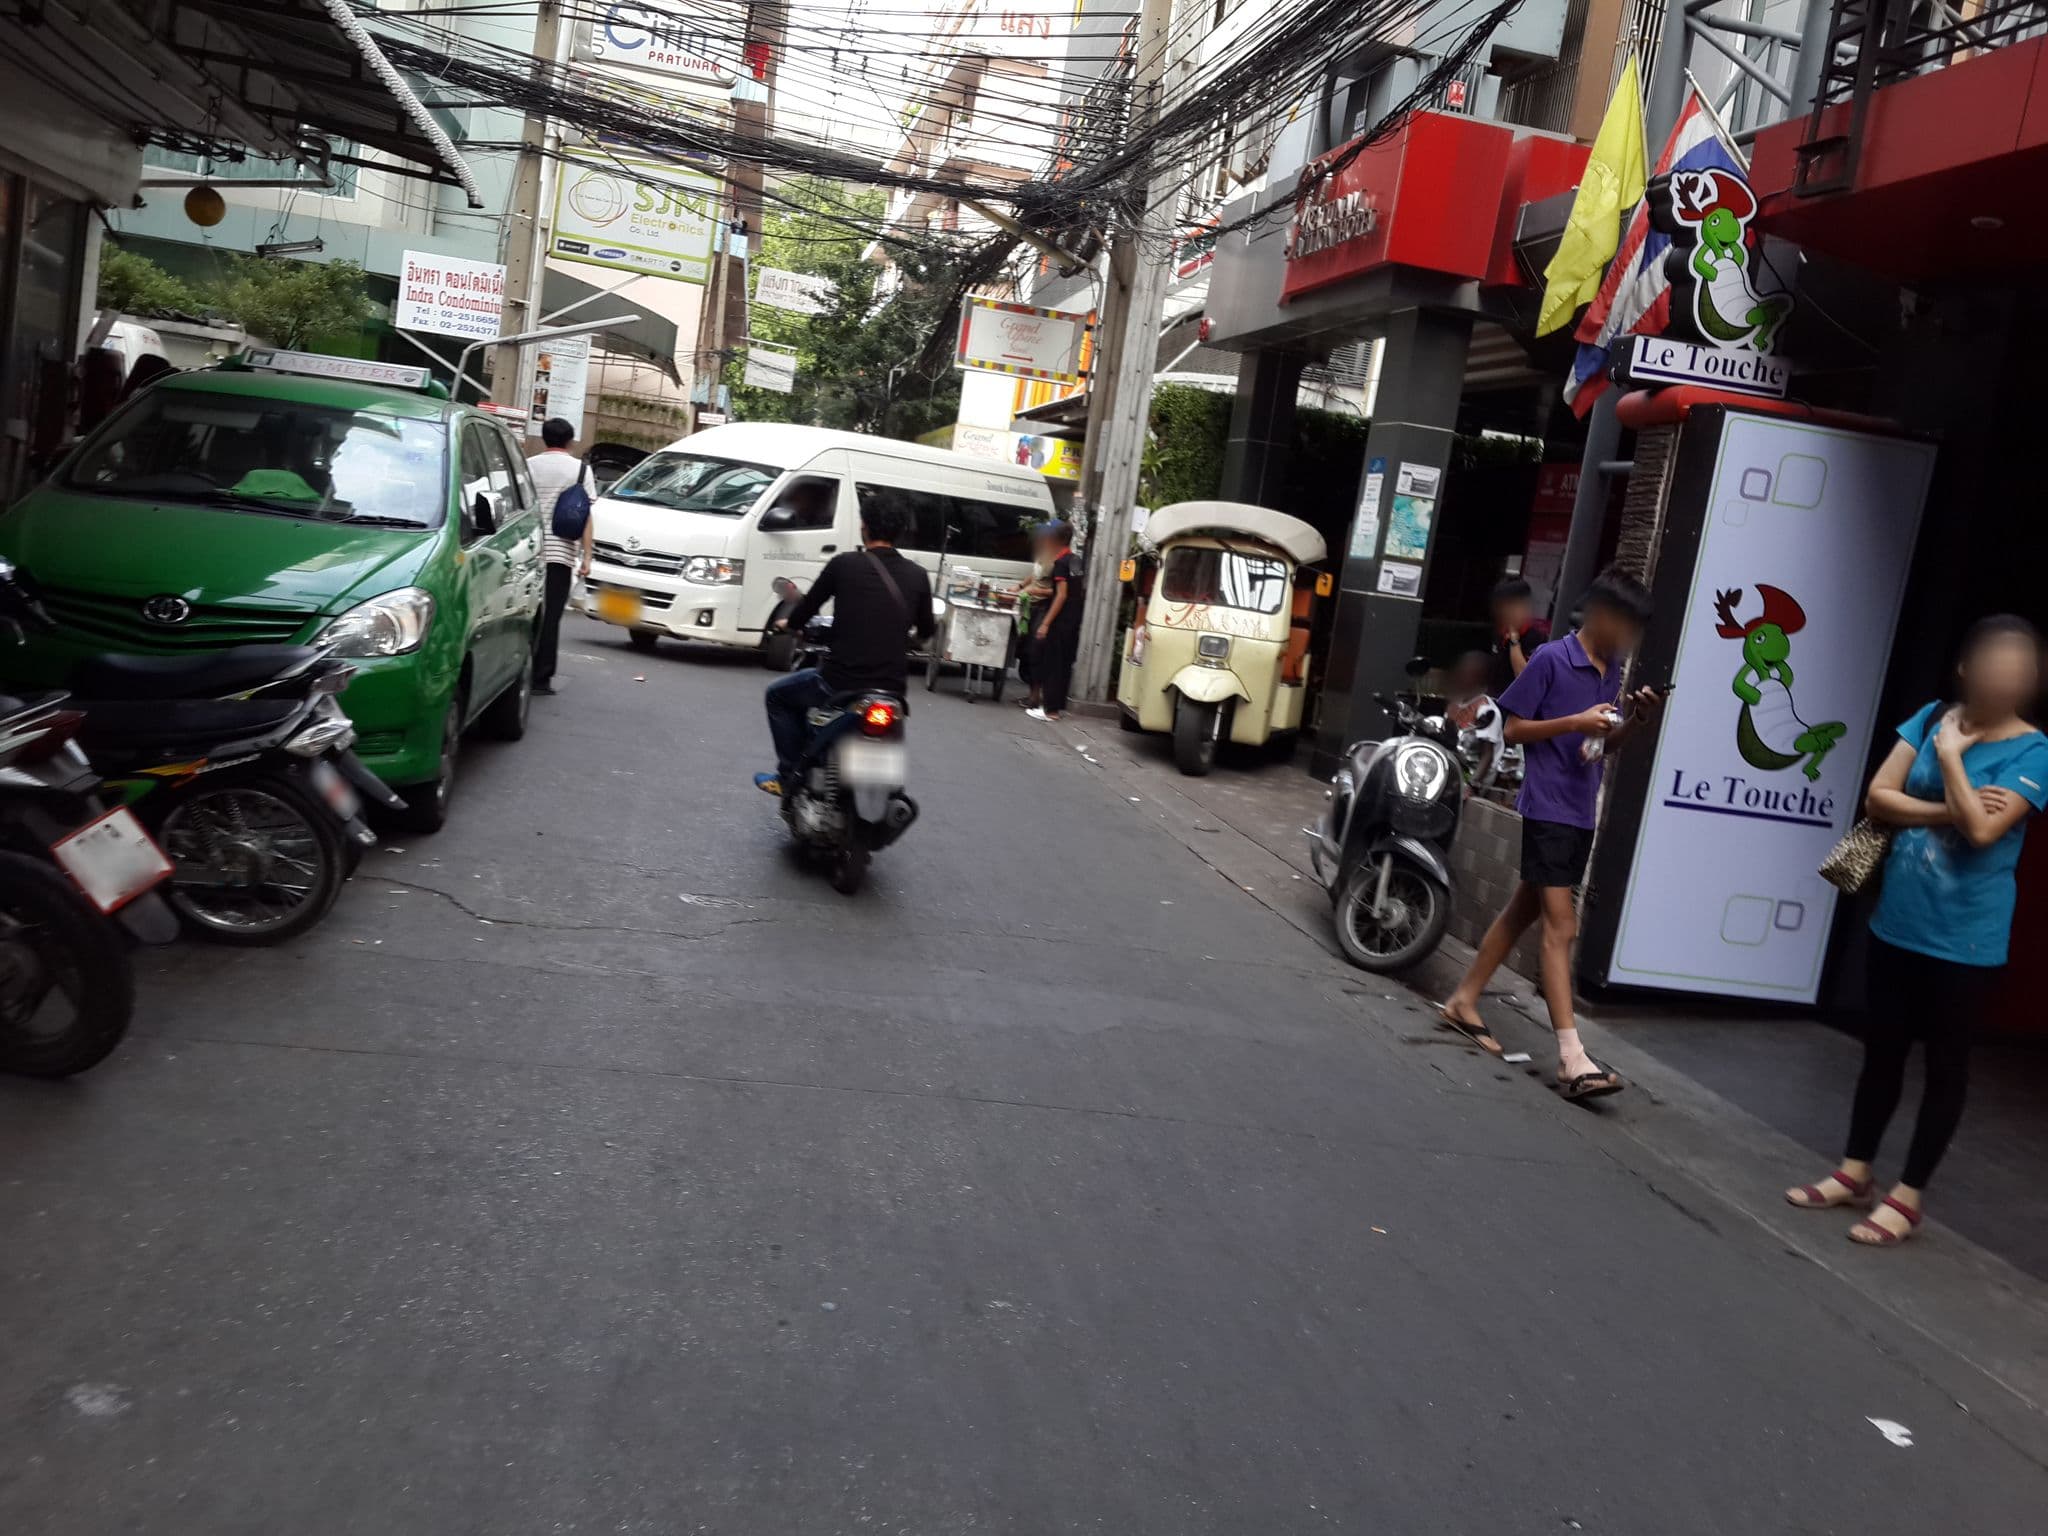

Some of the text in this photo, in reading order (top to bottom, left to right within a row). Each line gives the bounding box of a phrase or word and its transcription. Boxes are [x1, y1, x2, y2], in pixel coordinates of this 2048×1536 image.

[648, 50, 721, 74] PRATUNAM
[632, 183, 709, 222] SJM
[630, 212, 704, 236] Electronics
[406, 285, 434, 304] Indra
[1640, 337, 1675, 367] Le
[1671, 768, 1712, 802] Le
